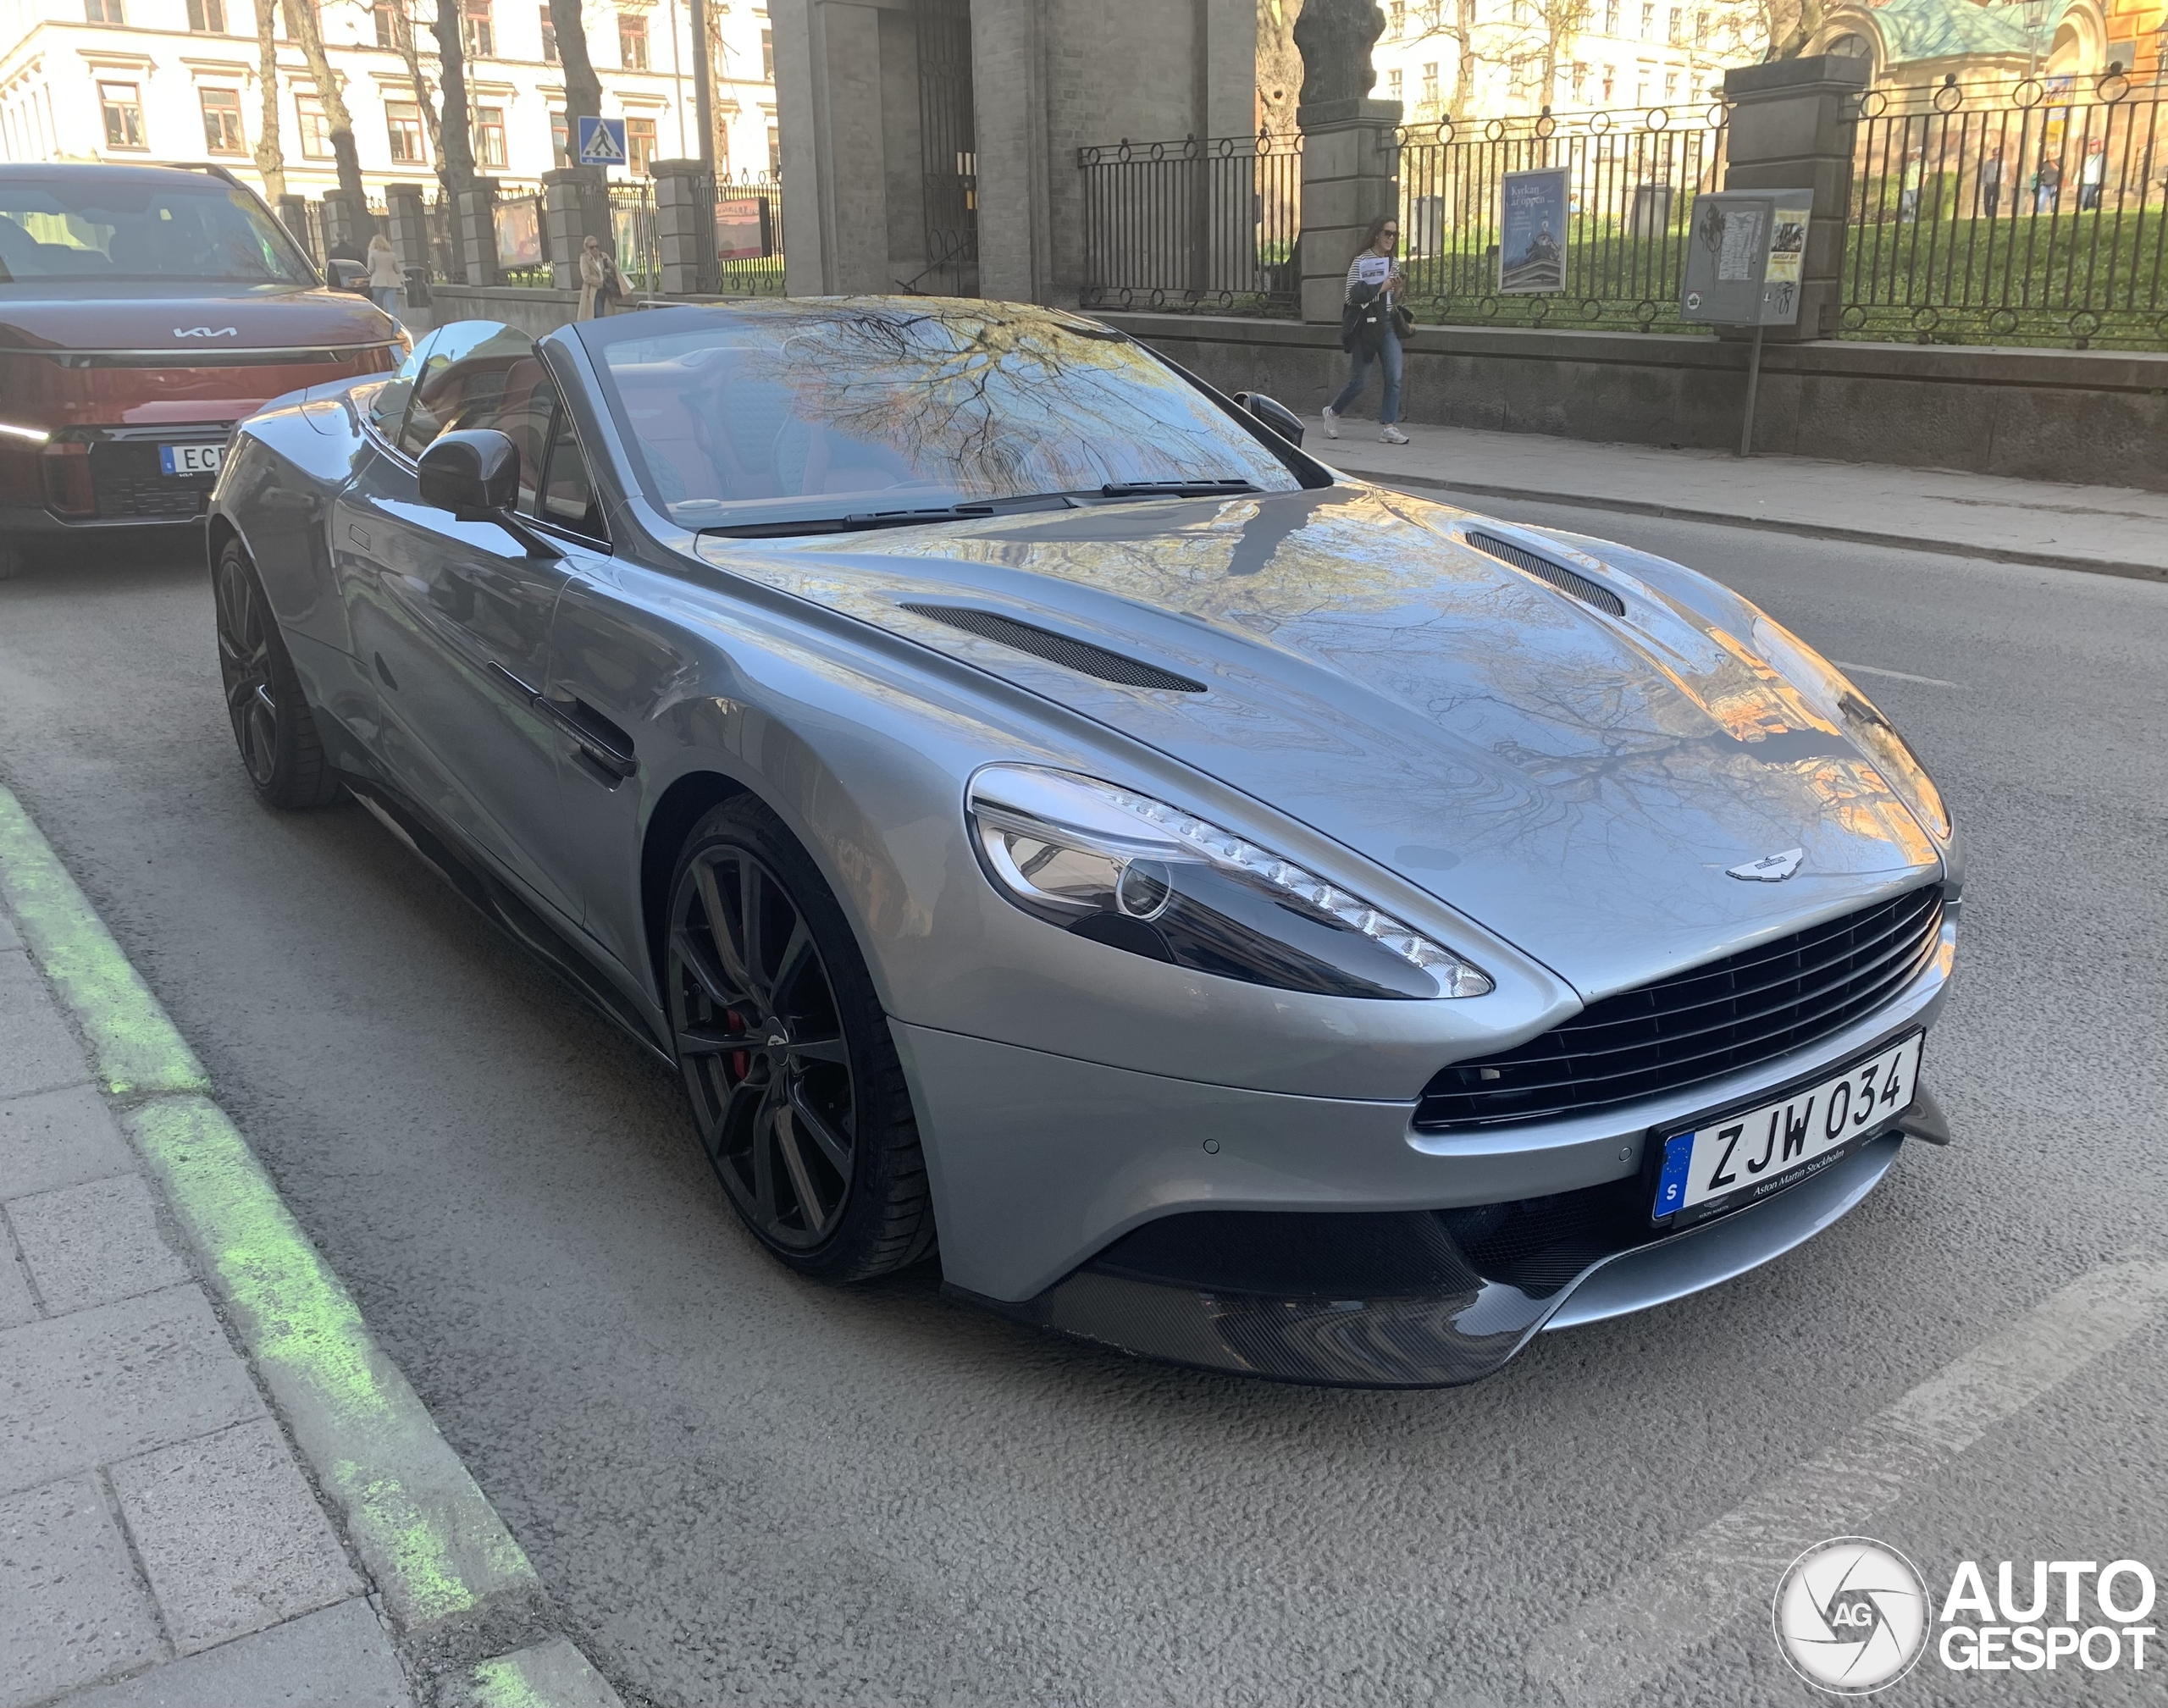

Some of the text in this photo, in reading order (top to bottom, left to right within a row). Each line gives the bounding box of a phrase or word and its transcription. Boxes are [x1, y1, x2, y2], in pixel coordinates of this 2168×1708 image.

[1512, 185, 1540, 198] Kyrkan
[1707, 1051, 1903, 1191] ZJW 034
[1753, 1149, 1845, 1197] Aston Martin Stockholm
[1666, 1184, 1678, 1201] S
